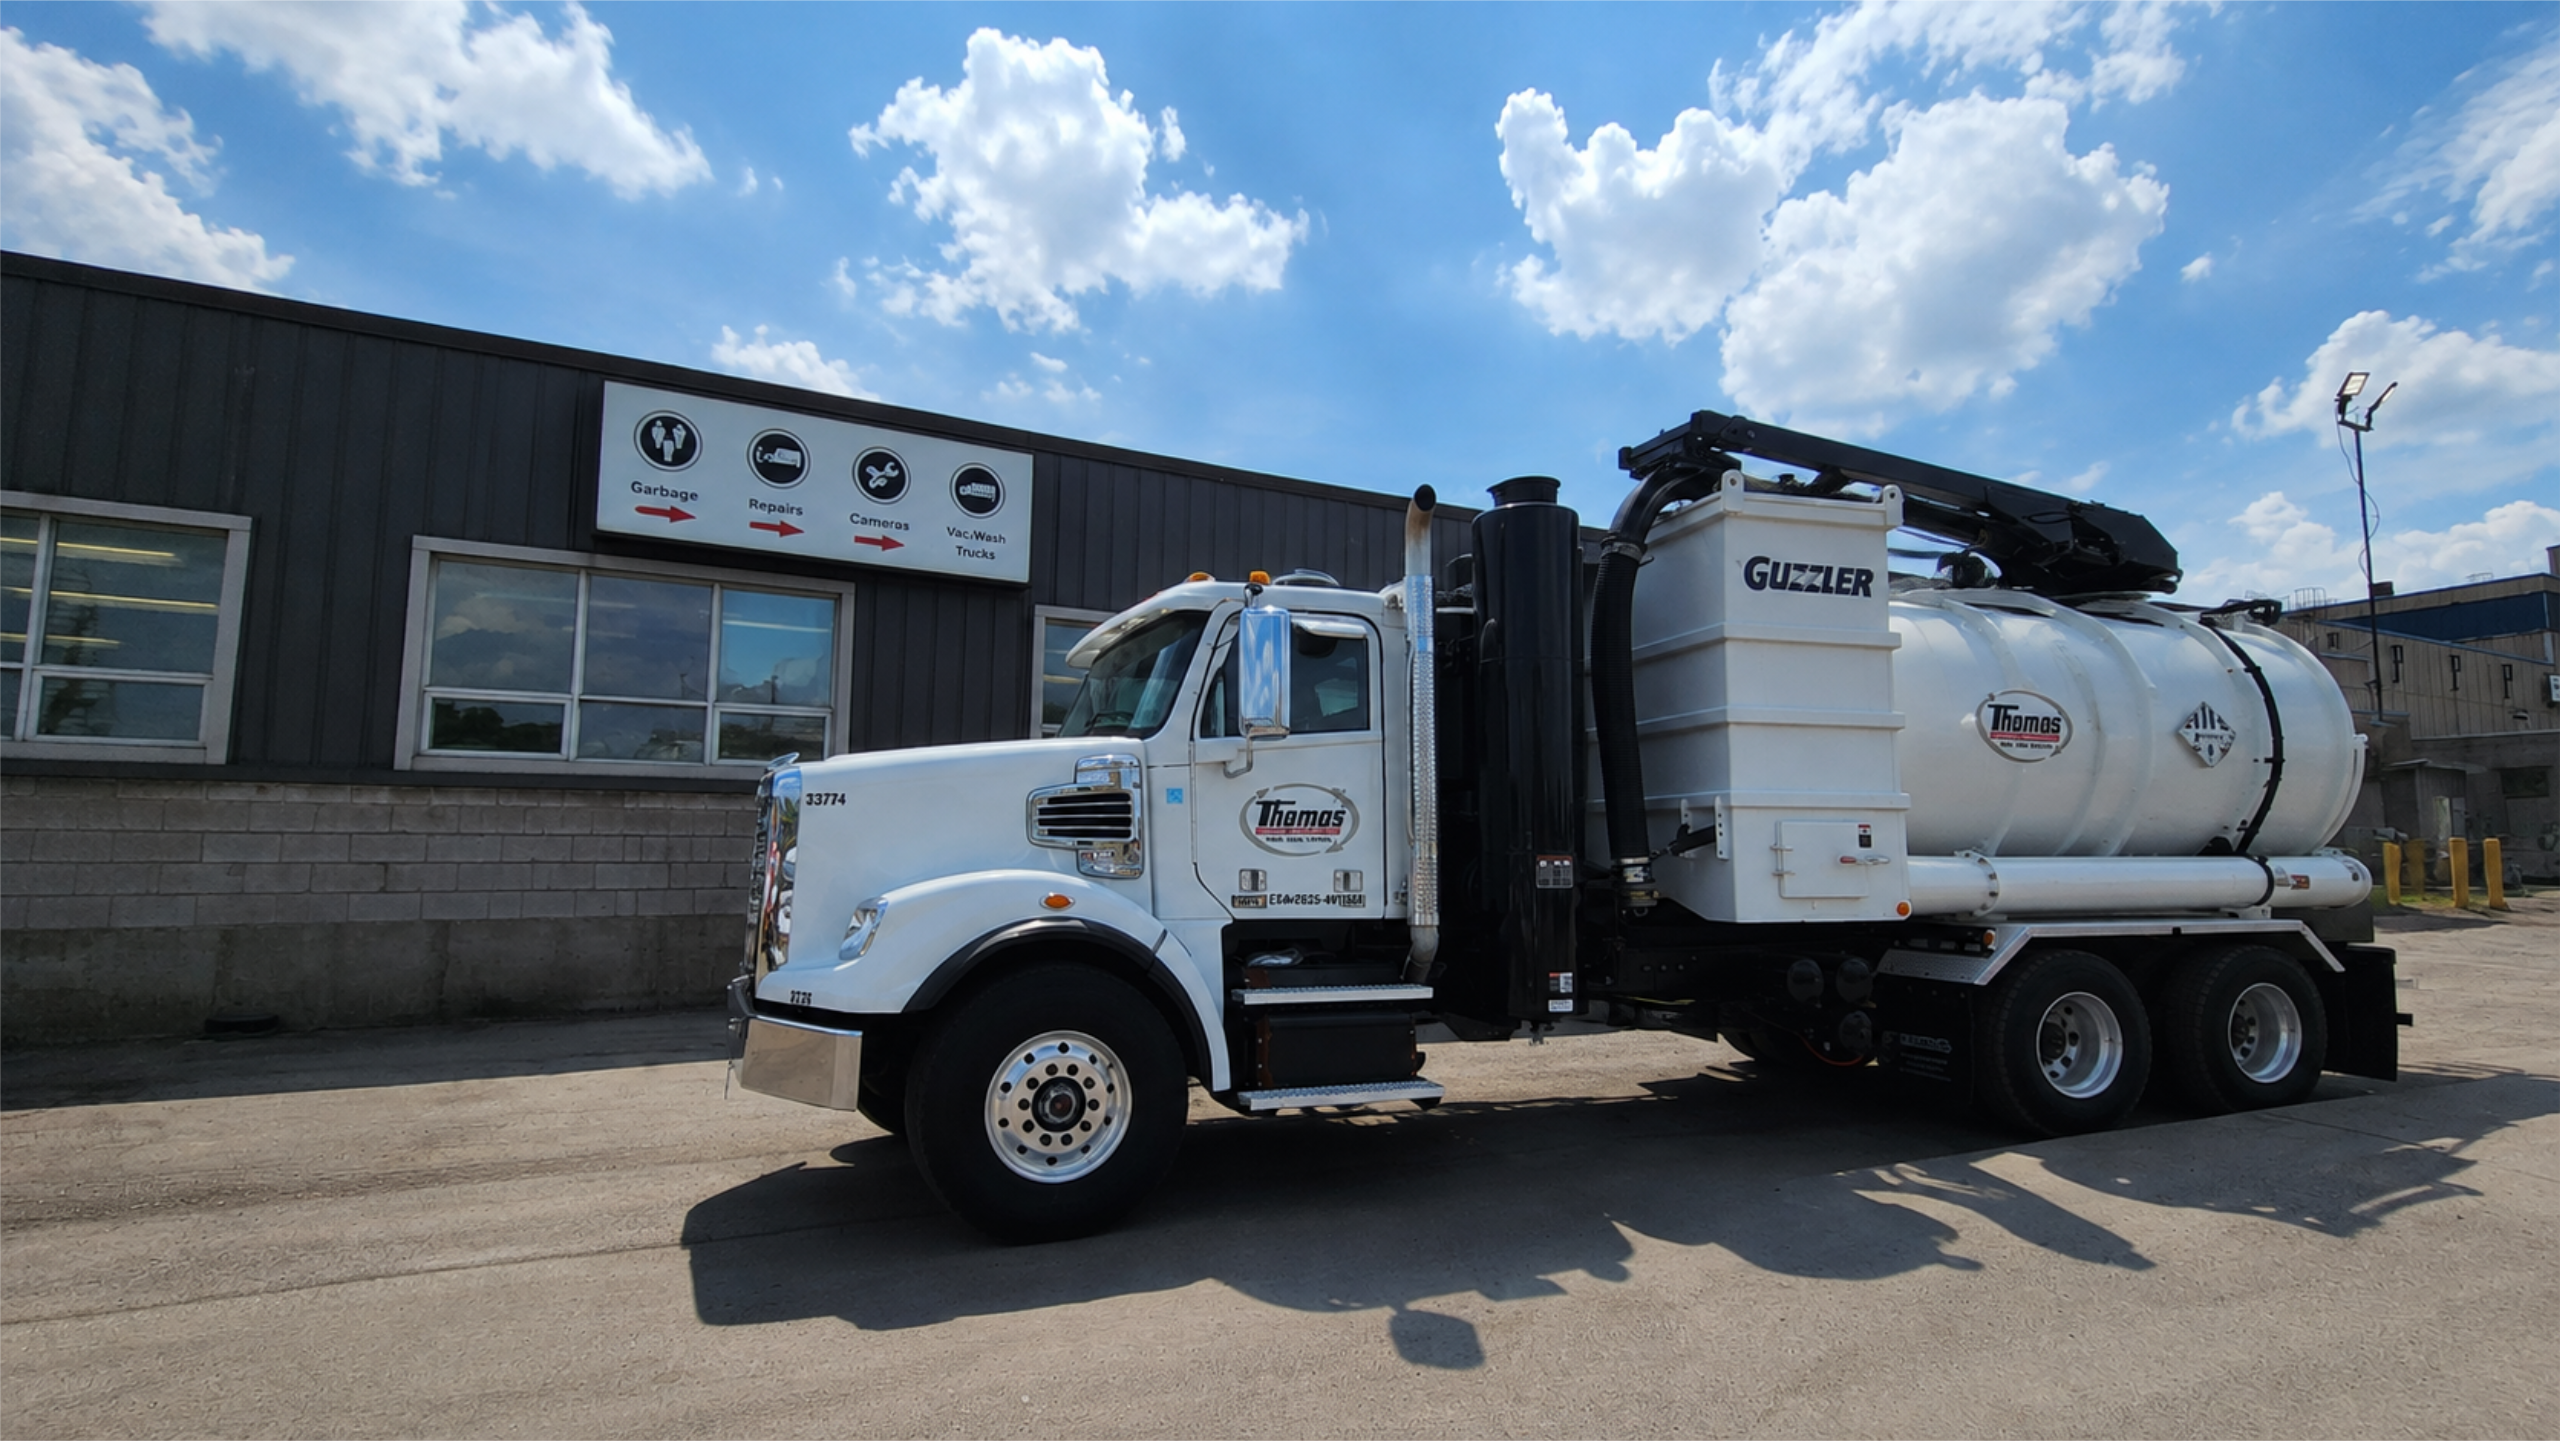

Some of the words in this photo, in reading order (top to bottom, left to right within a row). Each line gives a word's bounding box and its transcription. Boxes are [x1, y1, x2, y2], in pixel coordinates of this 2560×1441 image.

[630, 480, 699, 503] Garbage
[749, 498, 803, 517] Repairs
[849, 512, 910, 531] Cameras
[955, 545, 996, 561] Trucks
[1743, 555, 1874, 598] GUZZLER
[1987, 703, 2062, 734] Thomas
[805, 792, 847, 806] 33774
[1255, 799, 1347, 828] Thomas
